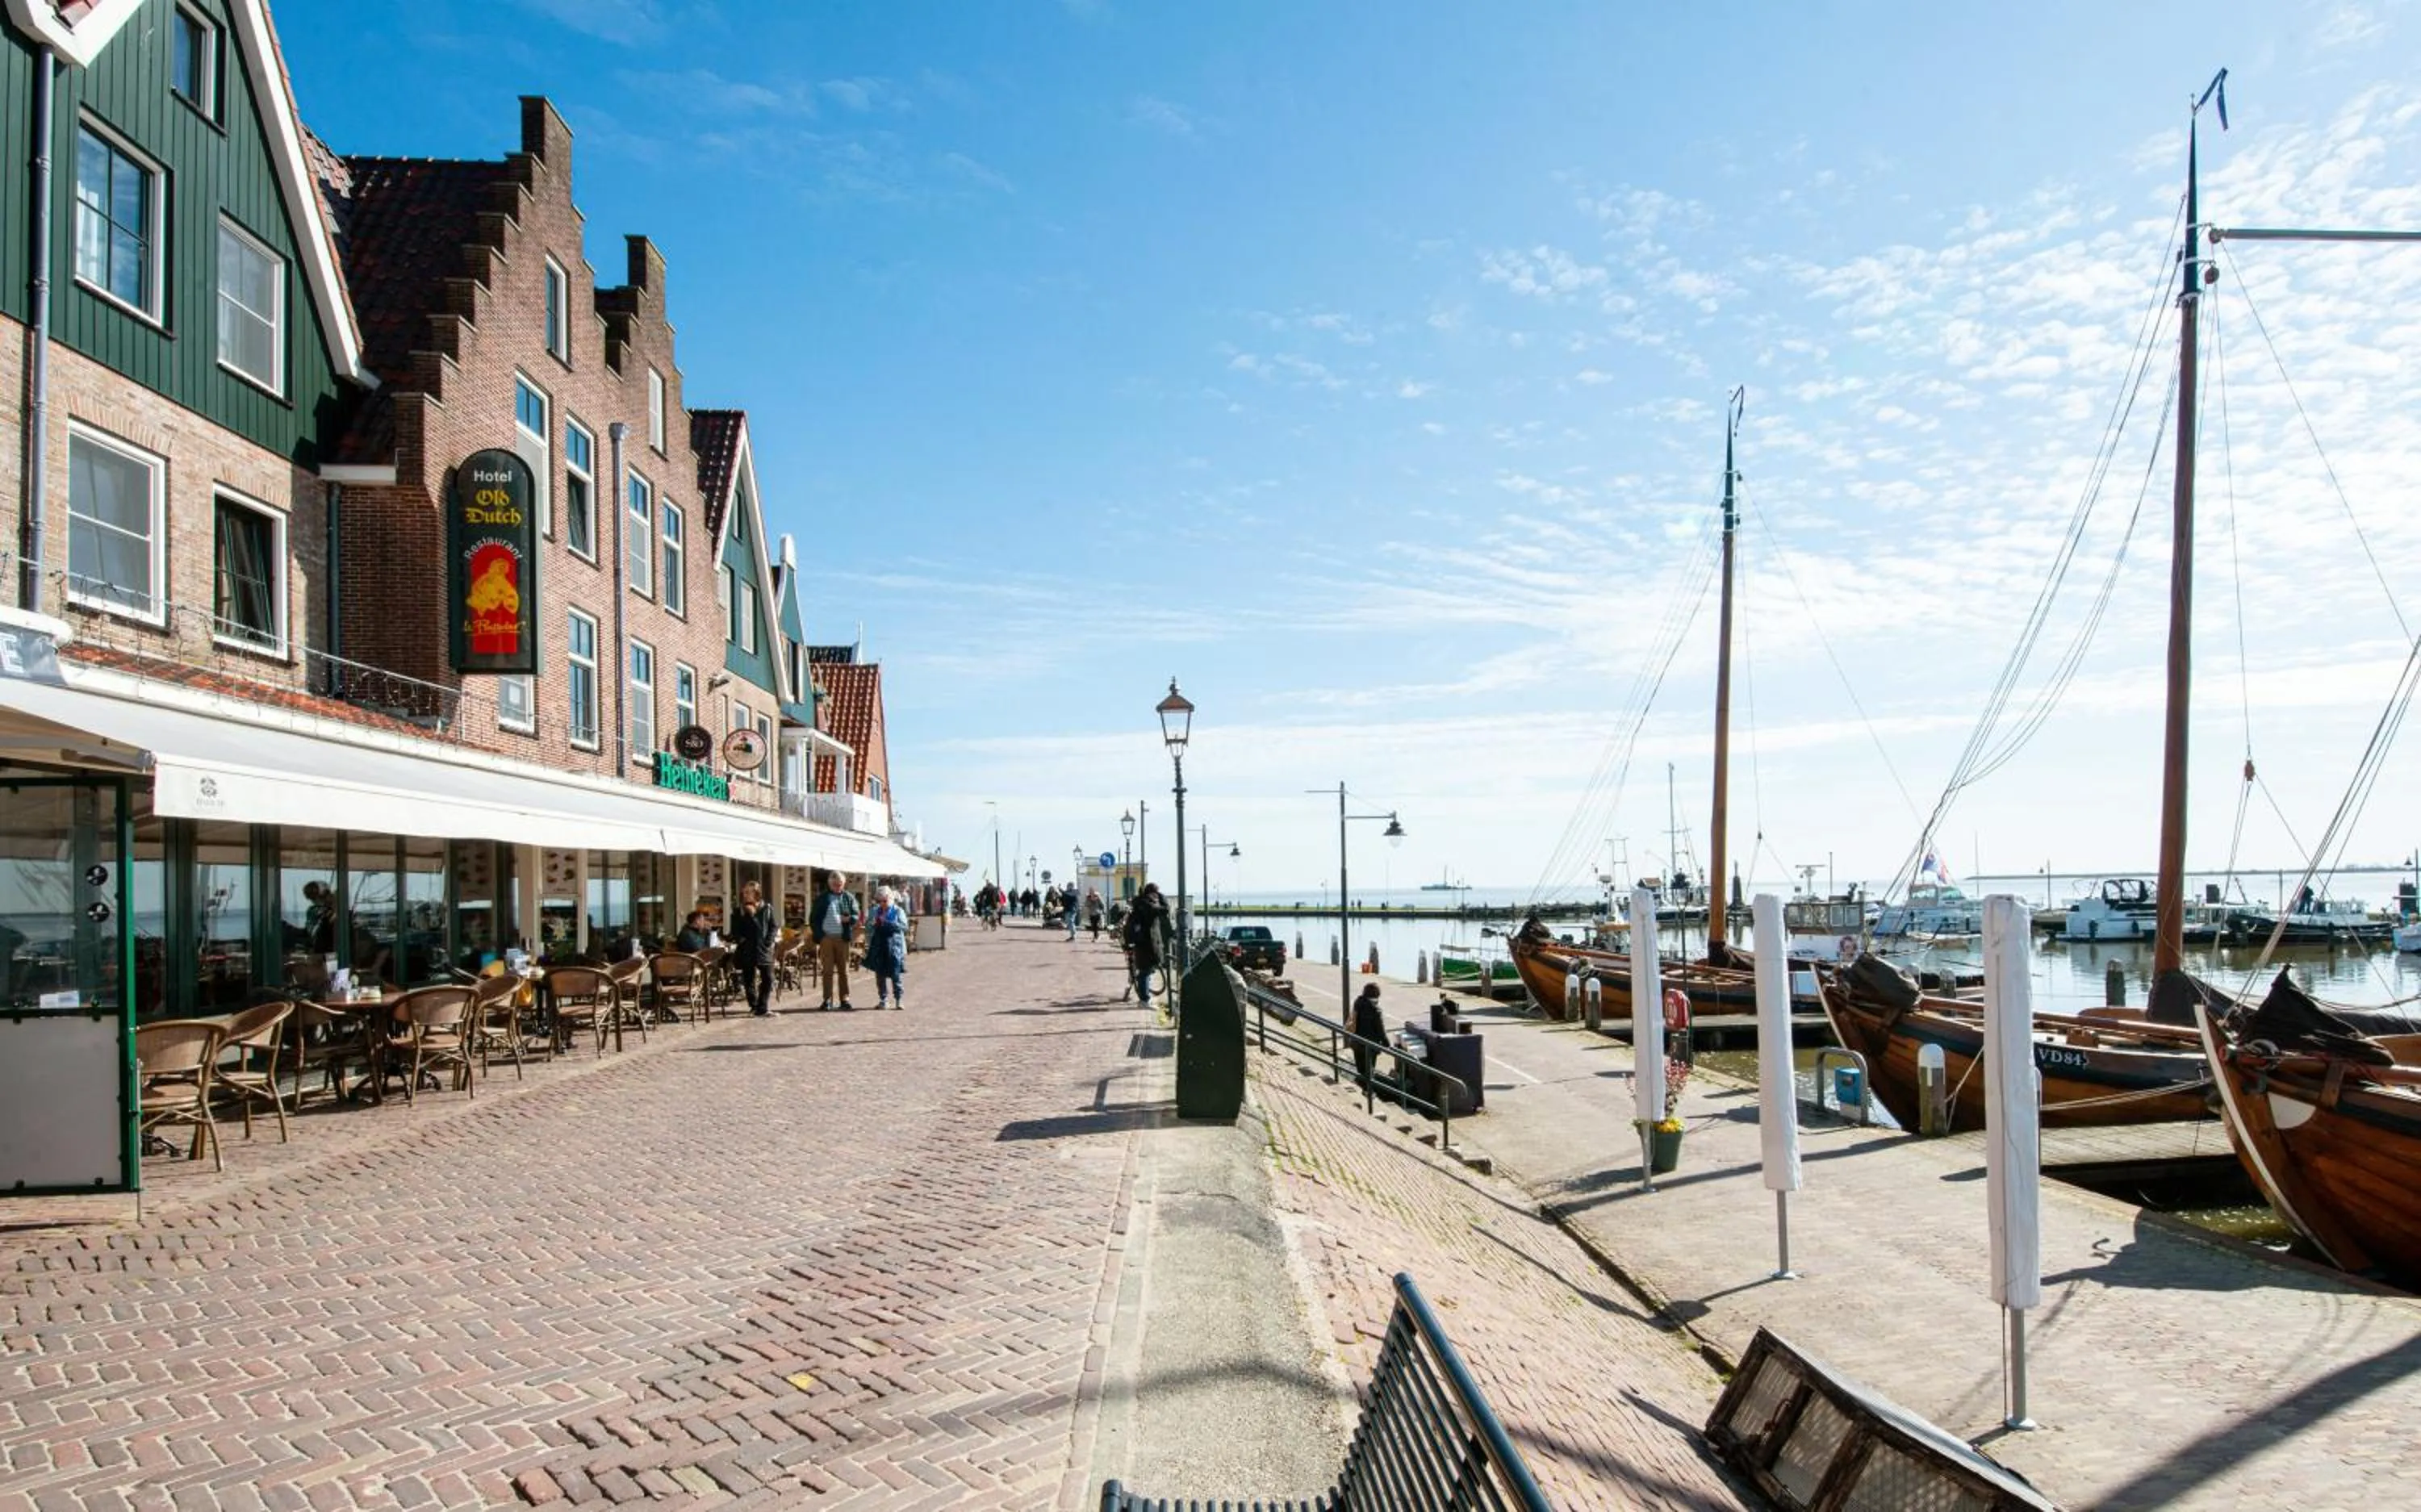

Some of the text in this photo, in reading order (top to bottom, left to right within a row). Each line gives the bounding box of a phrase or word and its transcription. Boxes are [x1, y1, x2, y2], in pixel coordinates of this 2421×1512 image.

[473, 470, 512, 482] Hotel
[476, 489, 510, 507] Old
[465, 507, 521, 526] Dutch
[464, 536, 523, 559] Restaurant
[660, 751, 728, 802] Heineken
